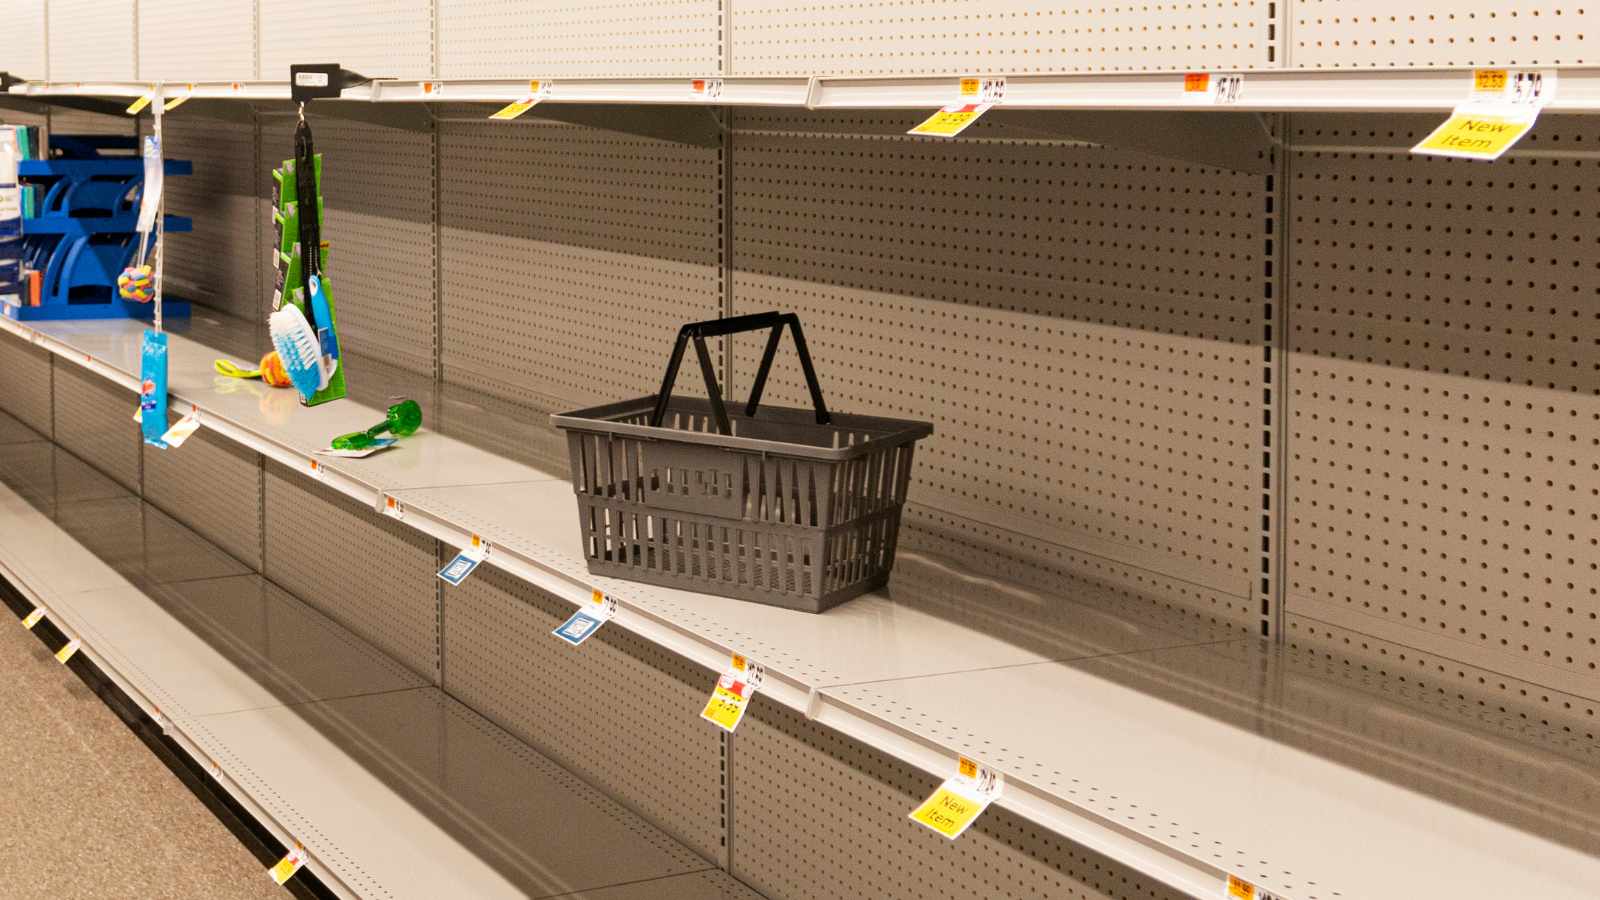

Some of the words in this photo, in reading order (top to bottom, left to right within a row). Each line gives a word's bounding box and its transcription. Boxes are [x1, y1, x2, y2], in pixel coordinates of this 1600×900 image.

[1461, 120, 1509, 132] New
[1443, 135, 1492, 147] Item
[941, 796, 967, 814] New
[926, 808, 955, 828] Item
